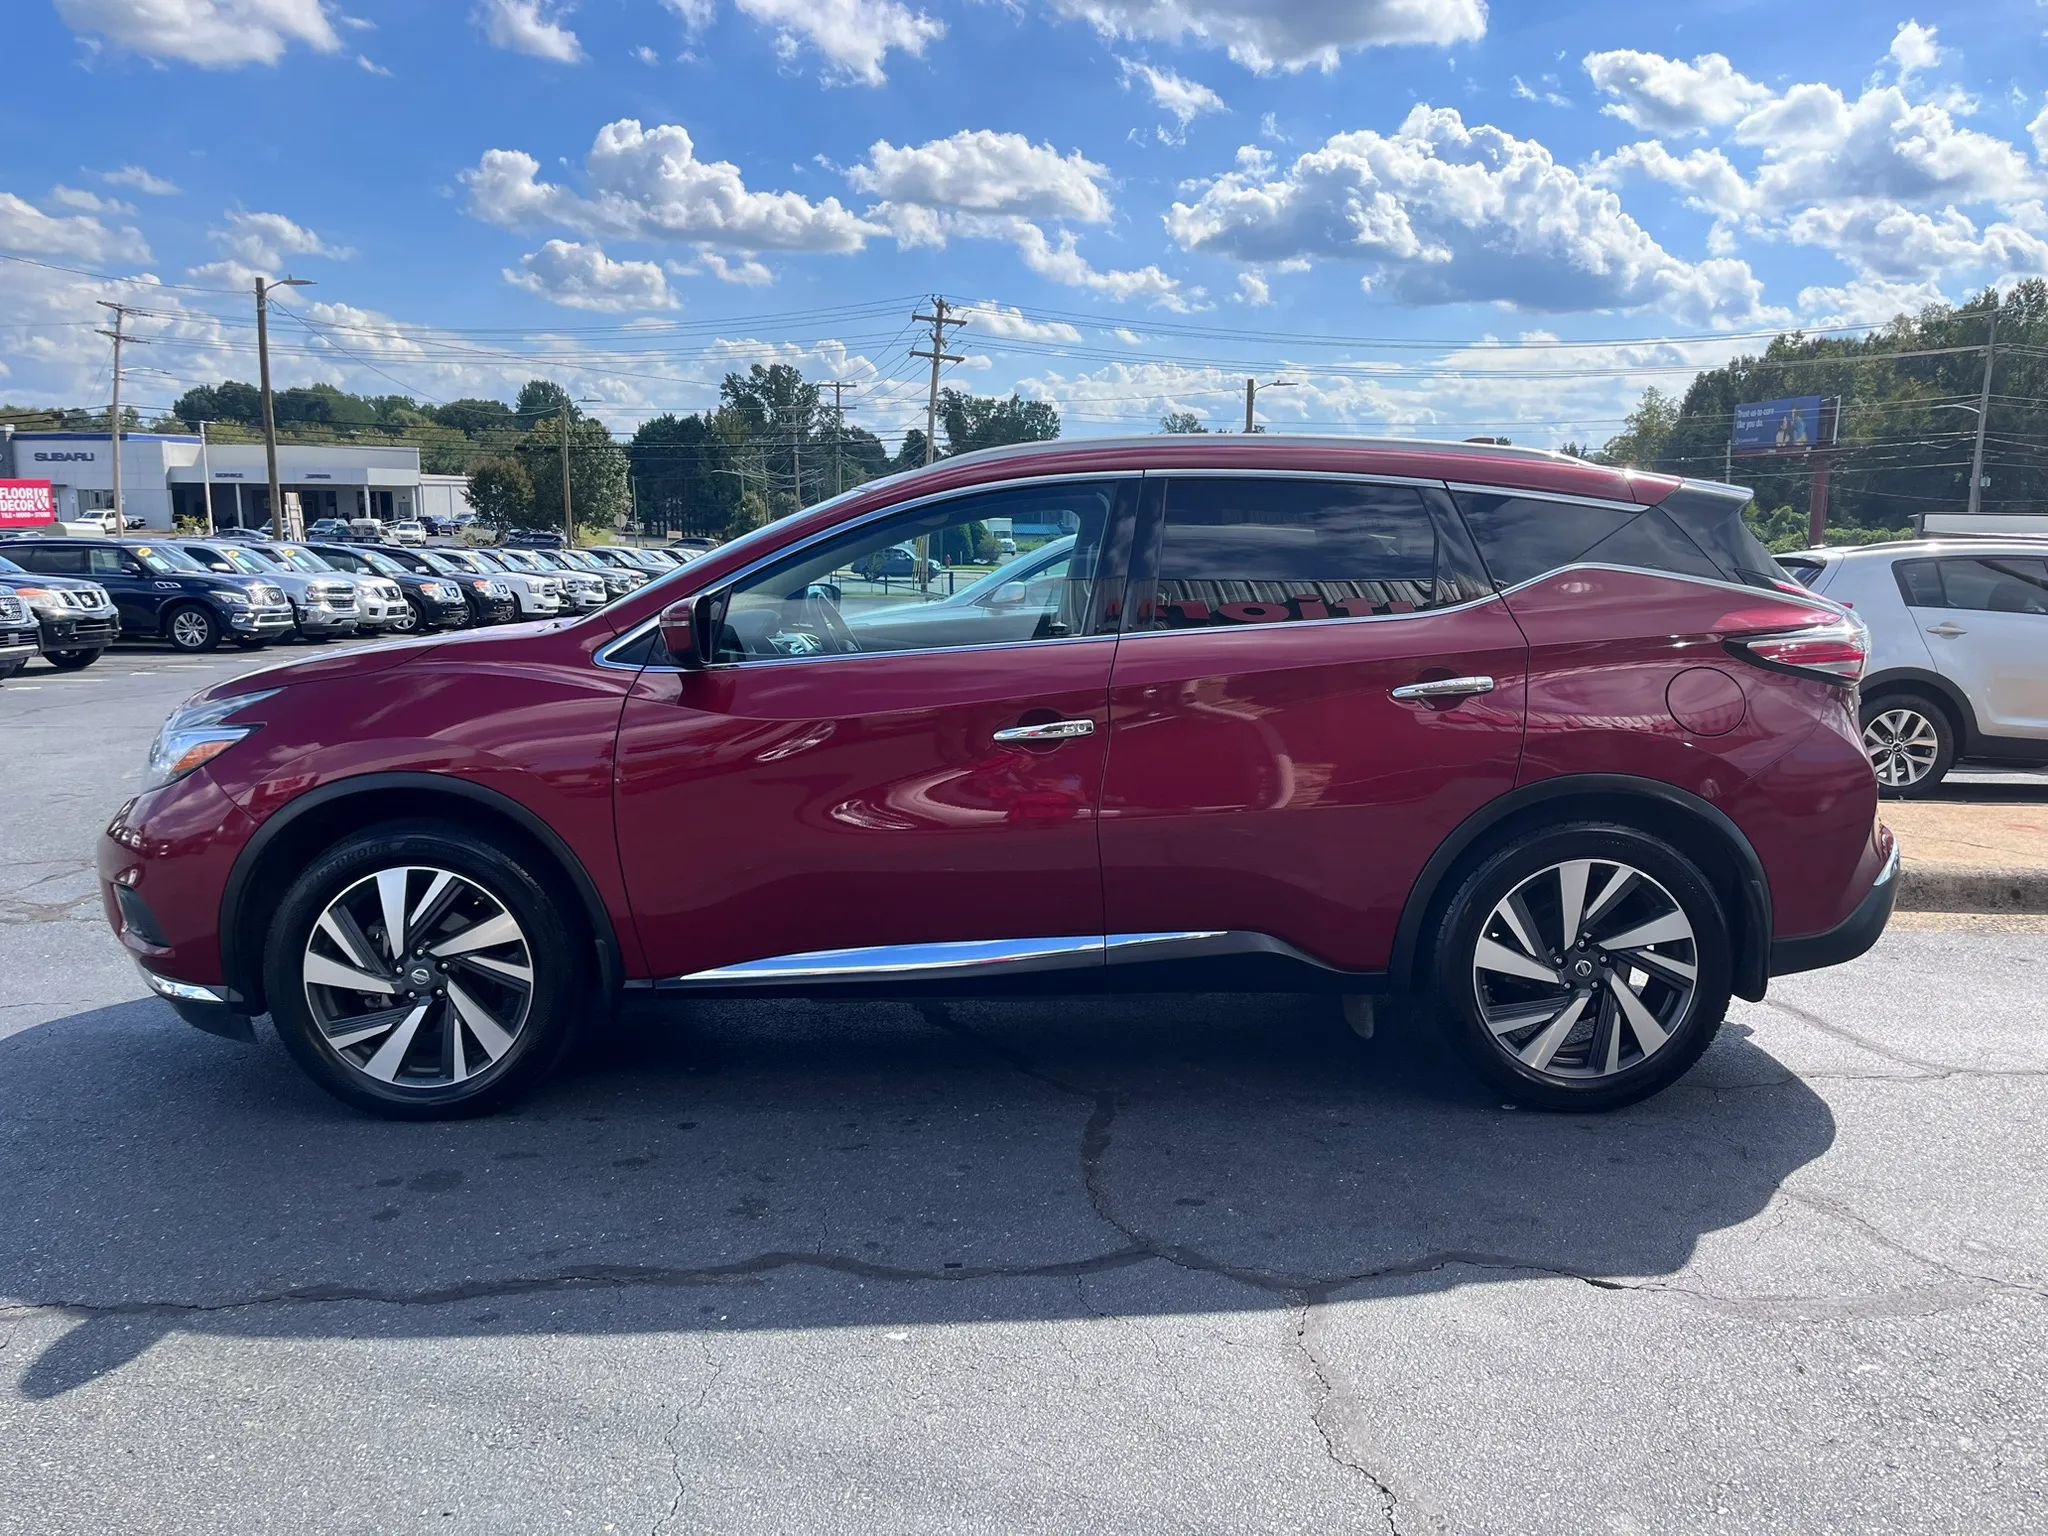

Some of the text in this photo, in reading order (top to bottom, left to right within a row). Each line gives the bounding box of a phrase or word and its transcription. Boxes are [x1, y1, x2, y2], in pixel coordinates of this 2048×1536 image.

[1745, 421, 1755, 431] you
[34, 452, 95, 462] SUBARU
[0, 487, 33, 499] FLOOR
[0, 499, 35, 511] DECOR
